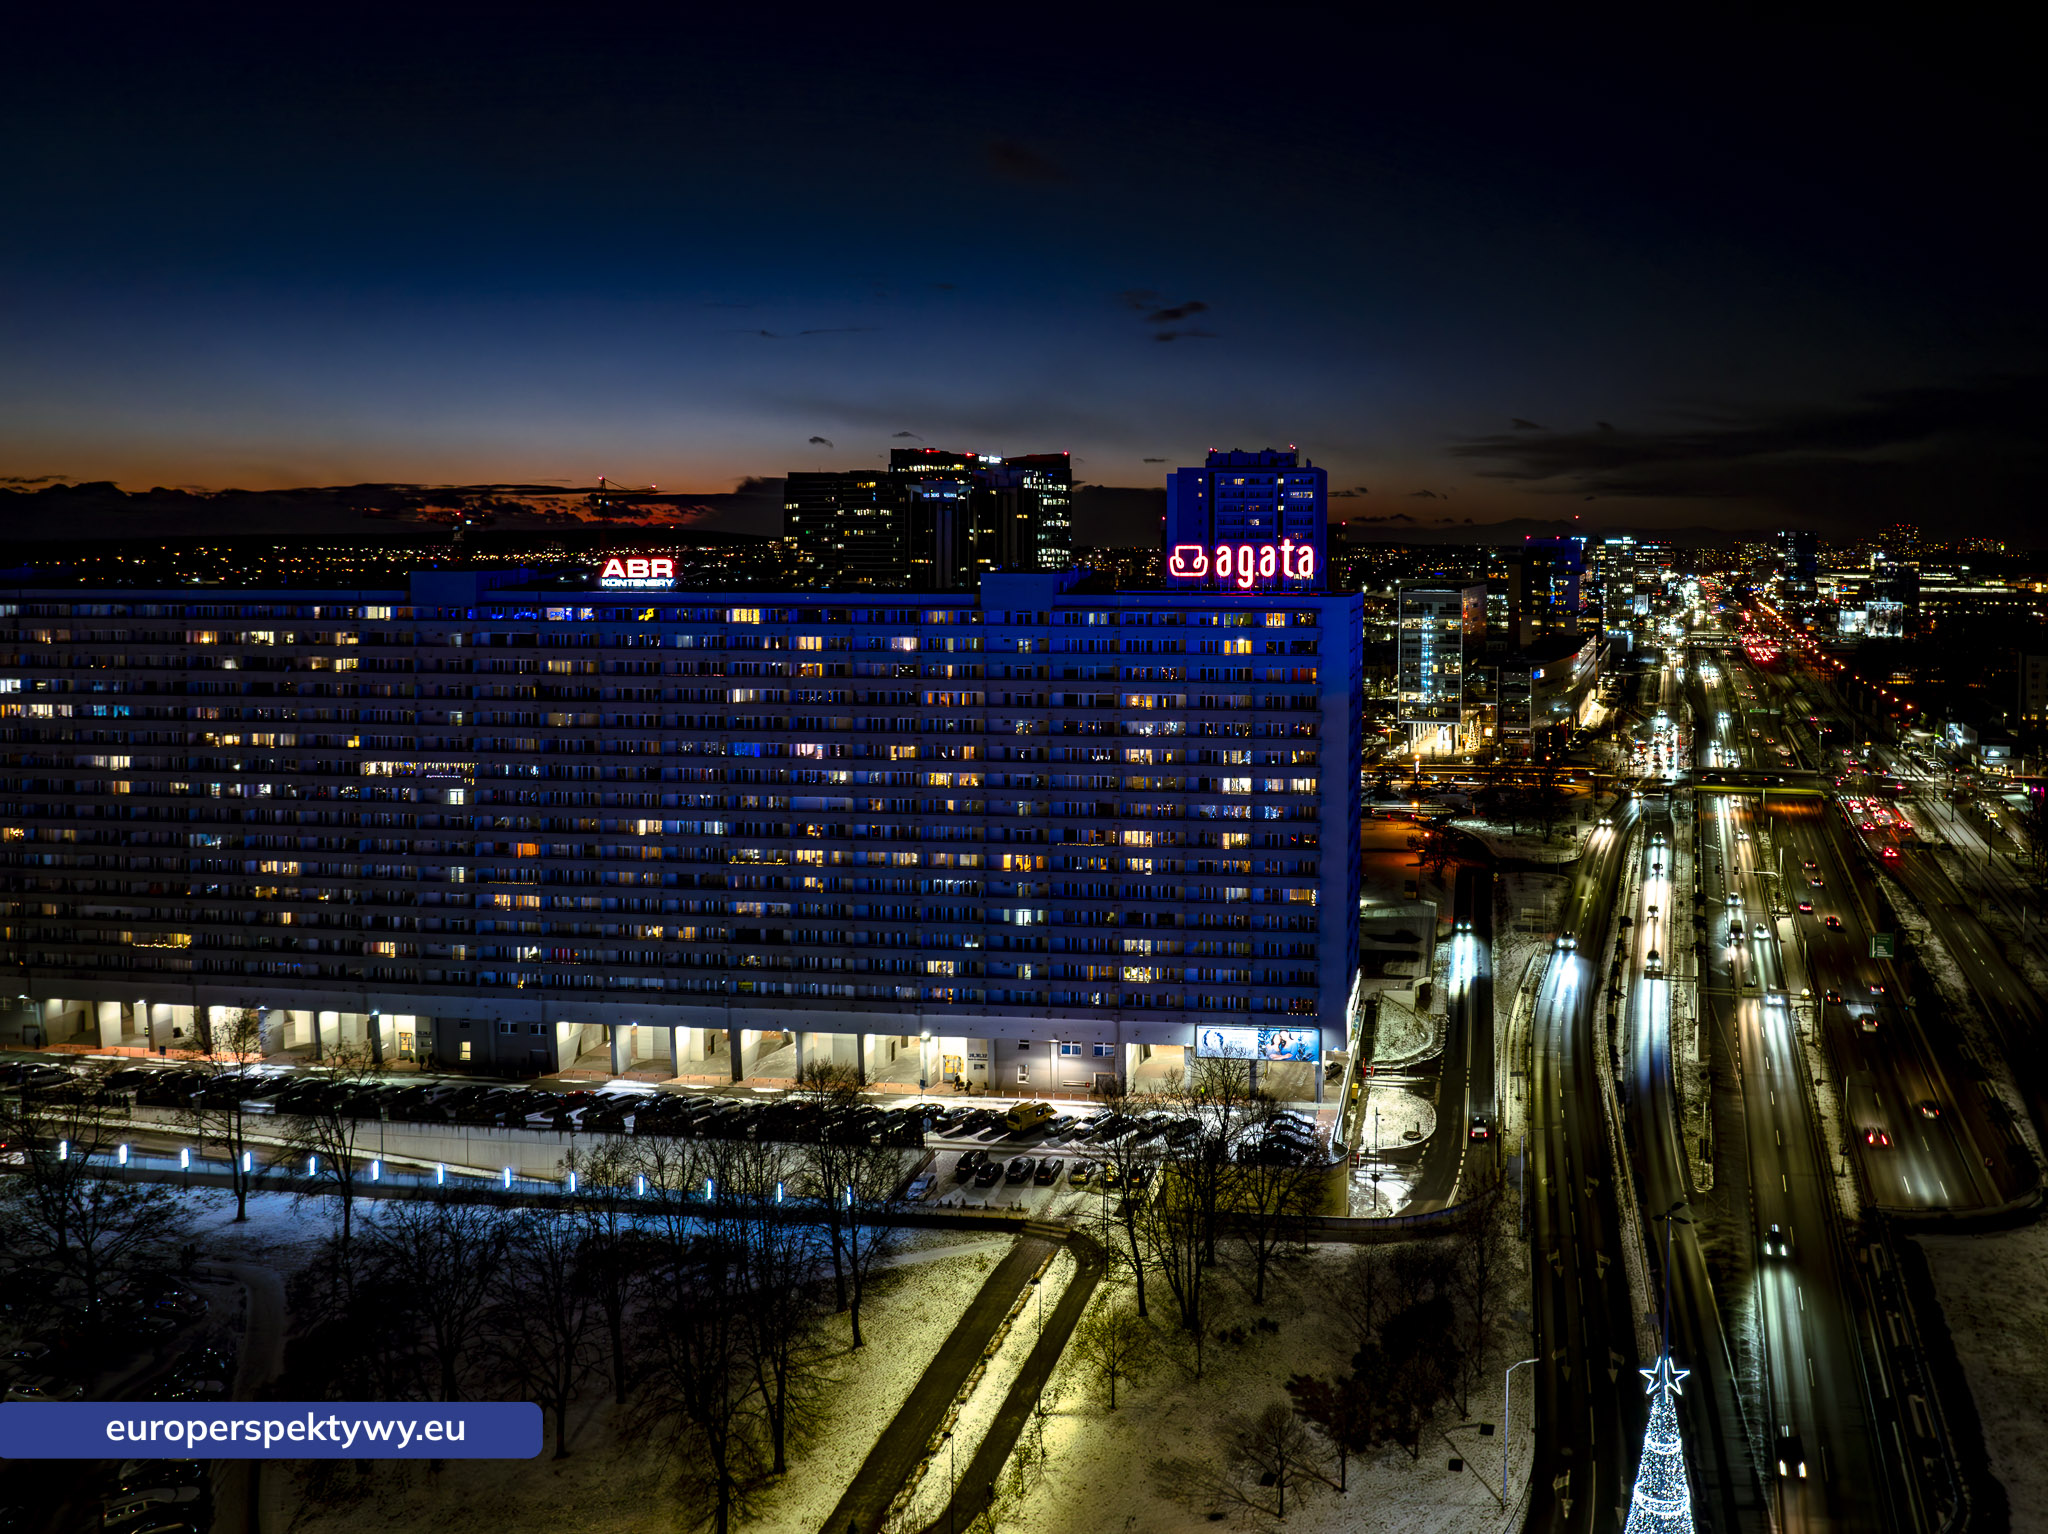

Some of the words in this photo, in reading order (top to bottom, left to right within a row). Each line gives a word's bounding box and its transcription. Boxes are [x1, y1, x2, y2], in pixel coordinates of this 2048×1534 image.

[602, 559, 673, 578] ABR
[1216, 538, 1314, 588] agata
[601, 579, 674, 587] KONTENERY
